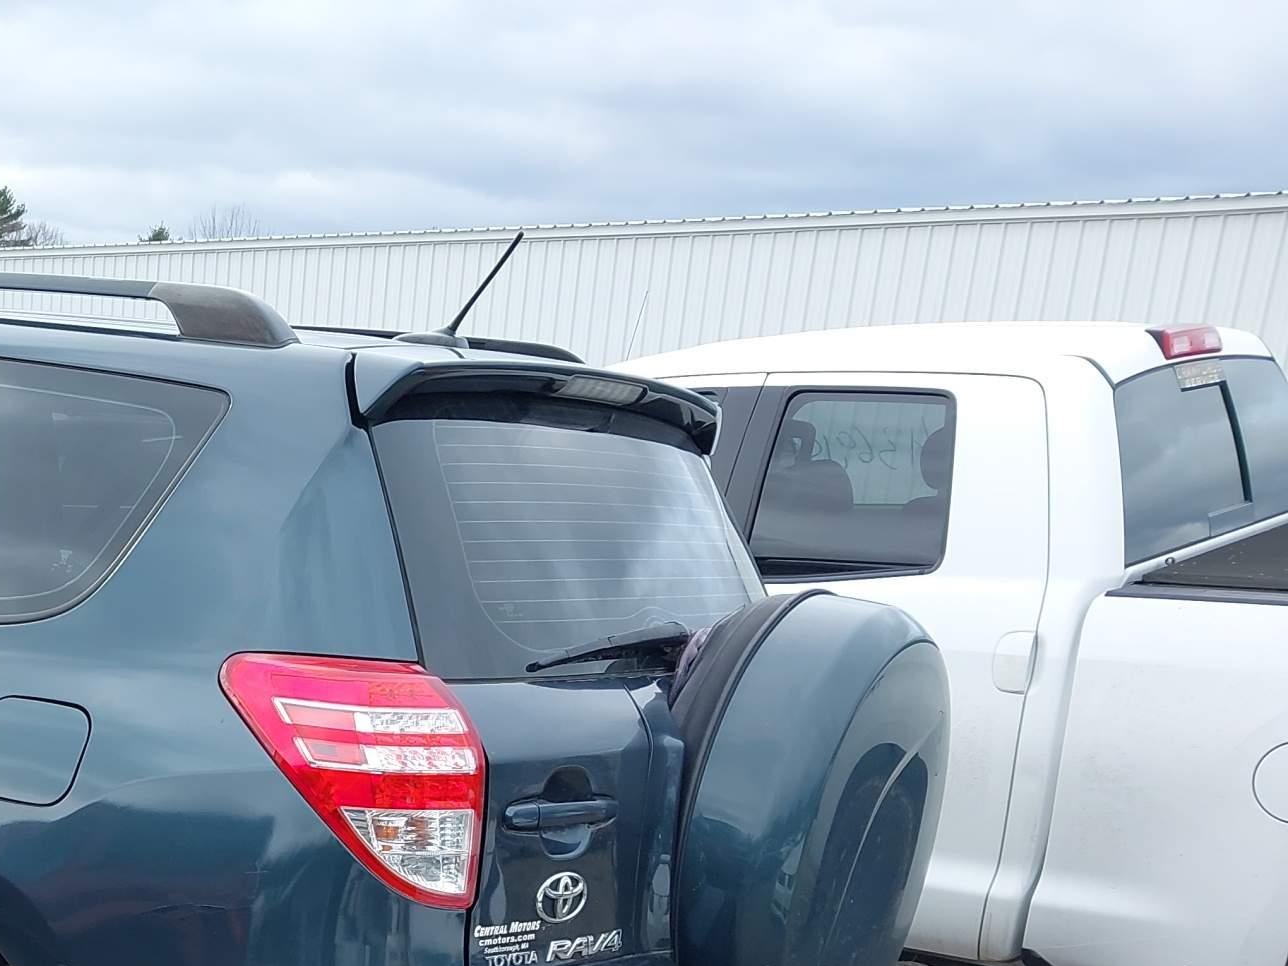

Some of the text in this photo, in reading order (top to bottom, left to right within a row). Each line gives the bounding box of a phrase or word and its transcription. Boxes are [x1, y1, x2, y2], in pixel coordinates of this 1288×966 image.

[474, 920, 541, 938] CENTRAL MOTORS
[478, 933, 535, 947] cmotors.com
[546, 928, 623, 962] RAV4
